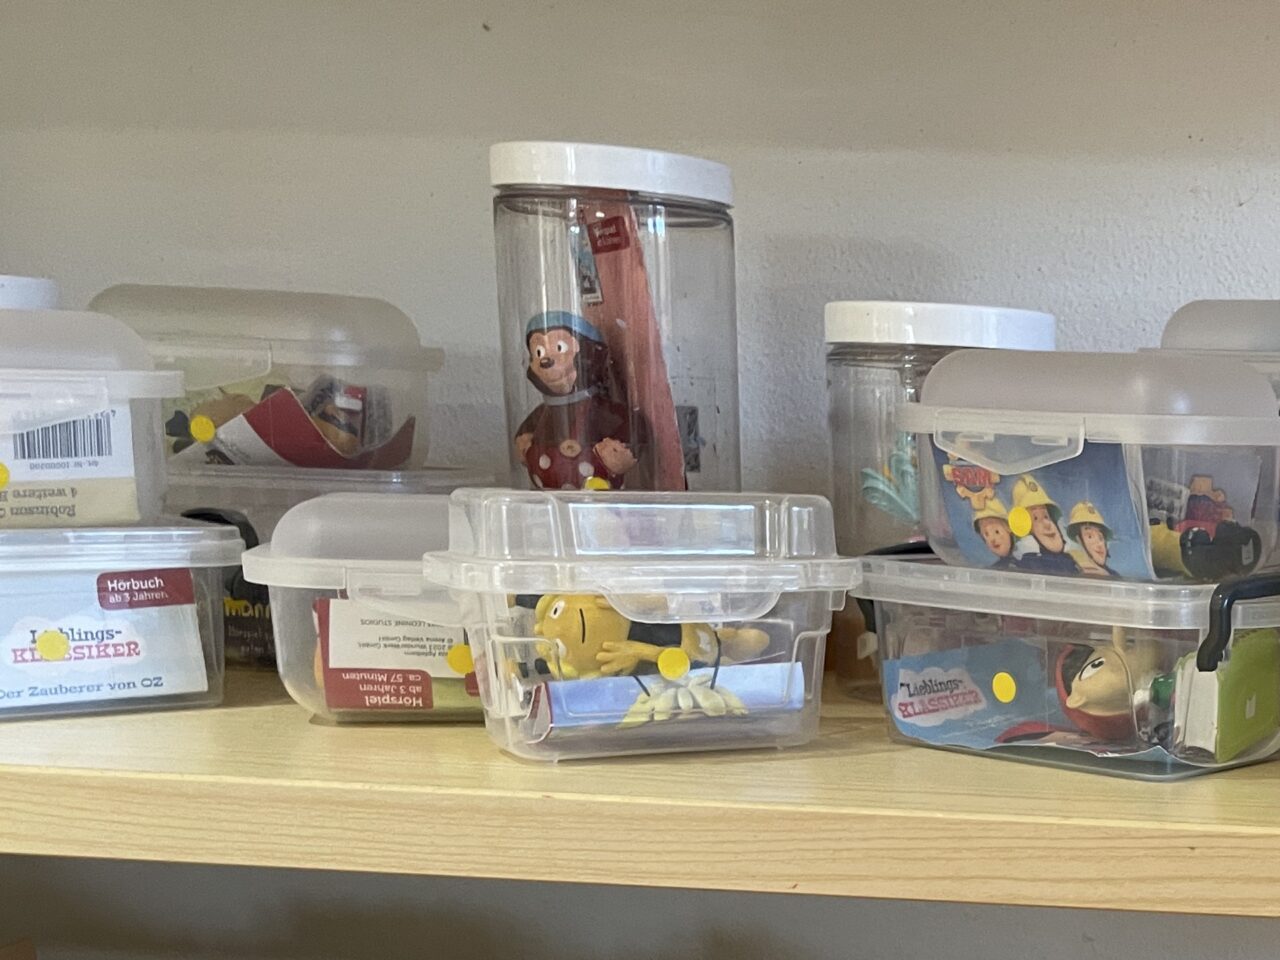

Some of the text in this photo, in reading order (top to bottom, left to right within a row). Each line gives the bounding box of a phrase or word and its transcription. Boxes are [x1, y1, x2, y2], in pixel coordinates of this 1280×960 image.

[13, 487, 67, 502] weitere
[10, 504, 76, 518] Robinson
[107, 577, 165, 592] Hörbuch
[108, 590, 169, 604] ab 3 Jahren
[341, 672, 388, 683] Minuten
[390, 672, 403, 682] 57
[28, 682, 105, 698] Zauberer
[108, 679, 137, 692] von
[140, 676, 164, 689] OZ
[358, 682, 423, 694] ab 3 Jahren
[364, 693, 424, 708] Hörspiel
